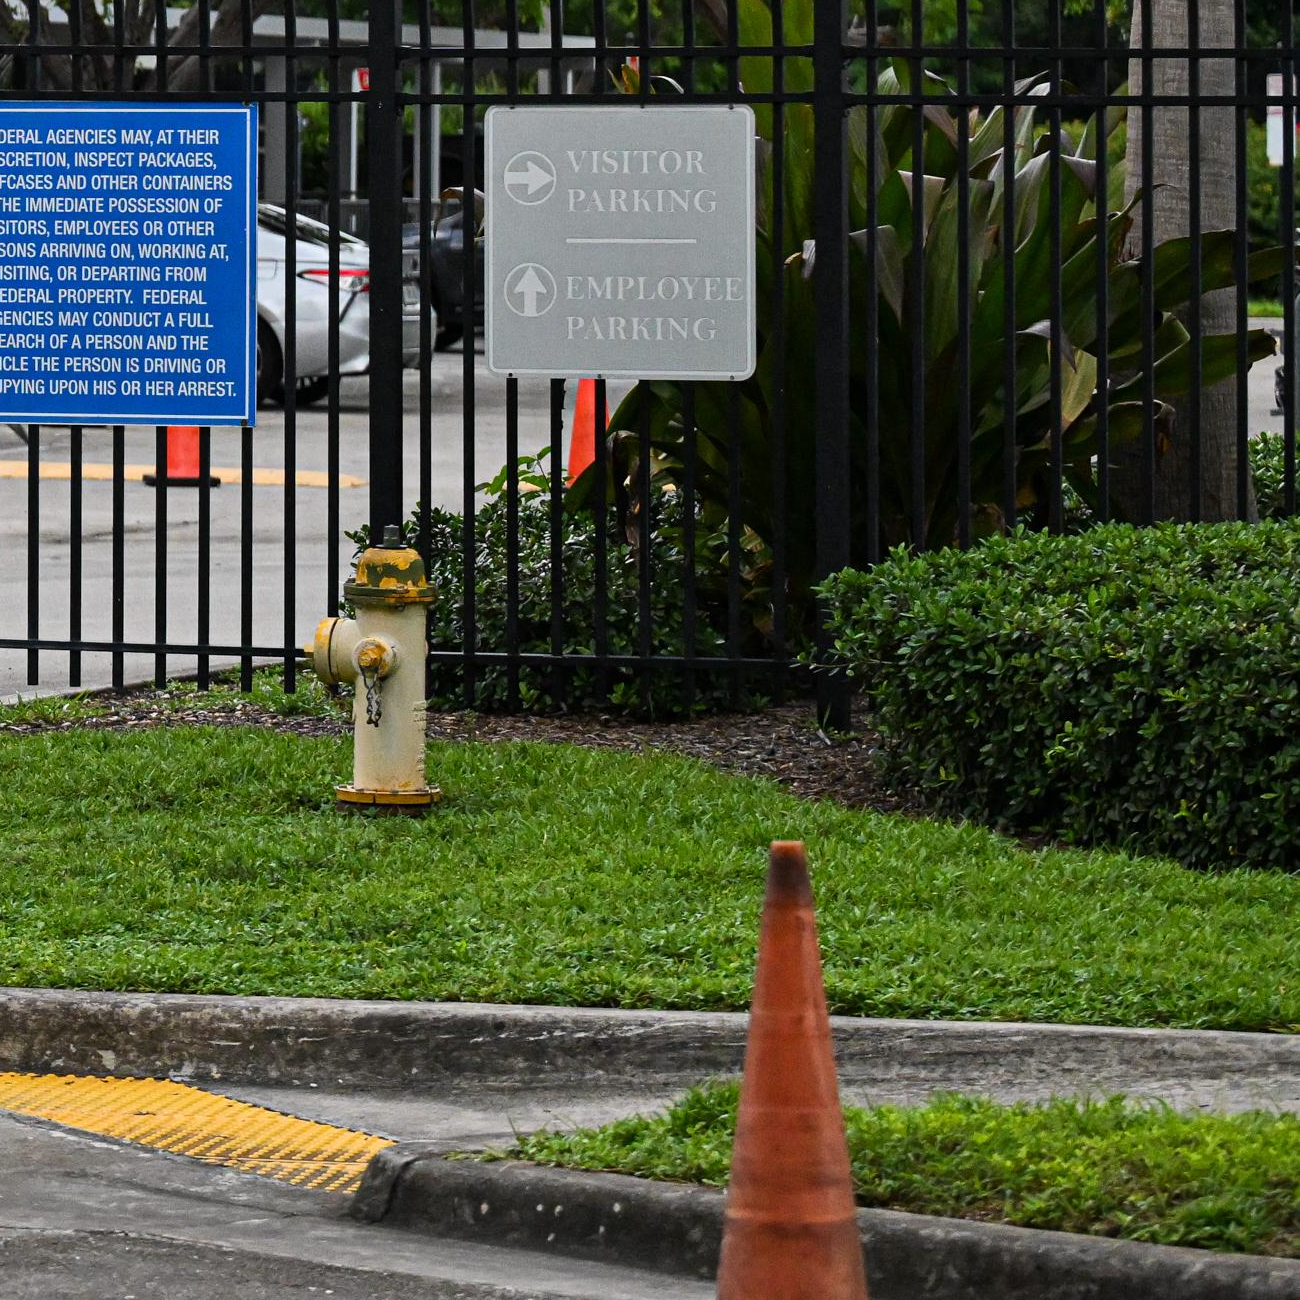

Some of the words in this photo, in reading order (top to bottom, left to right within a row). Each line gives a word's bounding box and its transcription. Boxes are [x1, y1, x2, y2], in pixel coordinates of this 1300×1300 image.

[45, 129, 117, 145] AGENCIES
[121, 129, 154, 145] MAY,
[156, 129, 175, 145] AT
[177, 129, 219, 145] THEIR
[74, 151, 135, 168] INSPECT
[138, 152, 217, 169] PACKAGES,
[566, 150, 706, 174] VISITOR
[56, 174, 87, 190] AND
[91, 174, 138, 190] OTHER
[142, 174, 233, 191] CONTAINERS
[25, 197, 104, 213] IMMEDIATE
[108, 197, 200, 214] POSSESSION
[203, 198, 223, 214] OF
[567, 188, 717, 213] PARKING
[54, 220, 139, 236] EMPLOYEES
[143, 220, 163, 236] OR
[167, 220, 215, 236] OTHER
[39, 242, 106, 259] ARRIVING
[110, 243, 135, 259] ON,
[137, 243, 206, 259] WORKING
[209, 244, 229, 259] AT,
[57, 265, 77, 281] OR
[81, 265, 161, 282] DEPARTING
[165, 266, 207, 282] FROM
[58, 288, 134, 304] PROPERTY.
[143, 289, 207, 305] FEDERAL
[566, 276, 744, 301] EMPLOYEE
[58, 311, 89, 327] MAY
[92, 311, 162, 328] CONDUCT
[164, 312, 175, 327] A
[178, 312, 214, 328] FULL
[566, 316, 717, 341] PARKING
[49, 333, 69, 349] OF
[71, 334, 82, 349] A
[85, 334, 143, 350] PERSON
[146, 335, 177, 350] AND
[180, 335, 209, 351] THE
[31, 356, 60, 372] THE
[64, 356, 121, 373] PERSON
[126, 357, 140, 373] IS
[144, 357, 202, 374] DRIVING
[205, 358, 226, 374] OR
[49, 379, 89, 395] UPON
[93, 379, 117, 396] HIS
[120, 380, 141, 396] OR
[145, 380, 175, 396] HER
[177, 381, 236, 397] ARREST.
